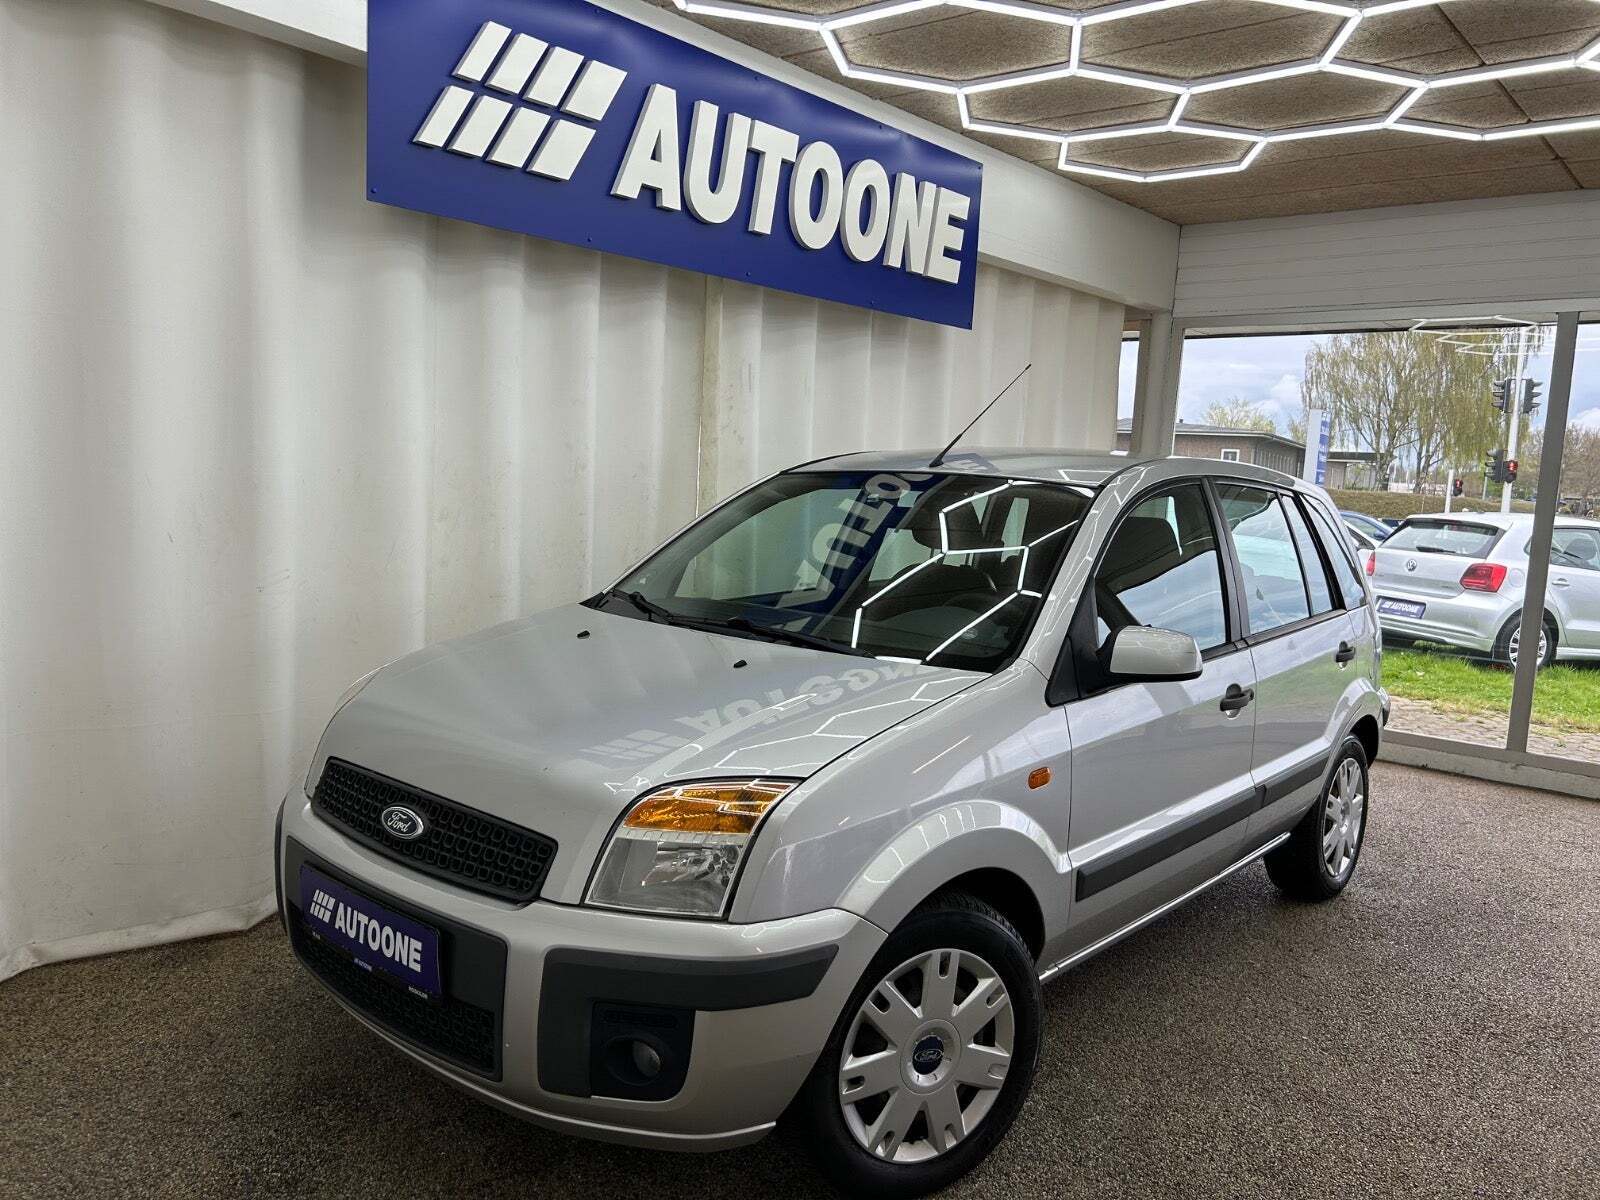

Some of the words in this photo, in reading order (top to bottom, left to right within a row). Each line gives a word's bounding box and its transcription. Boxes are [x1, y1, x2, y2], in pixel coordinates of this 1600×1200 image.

[610, 83, 971, 285] AUTOONE
[387, 811, 412, 832] Ford
[334, 902, 422, 973] AUTOONE
